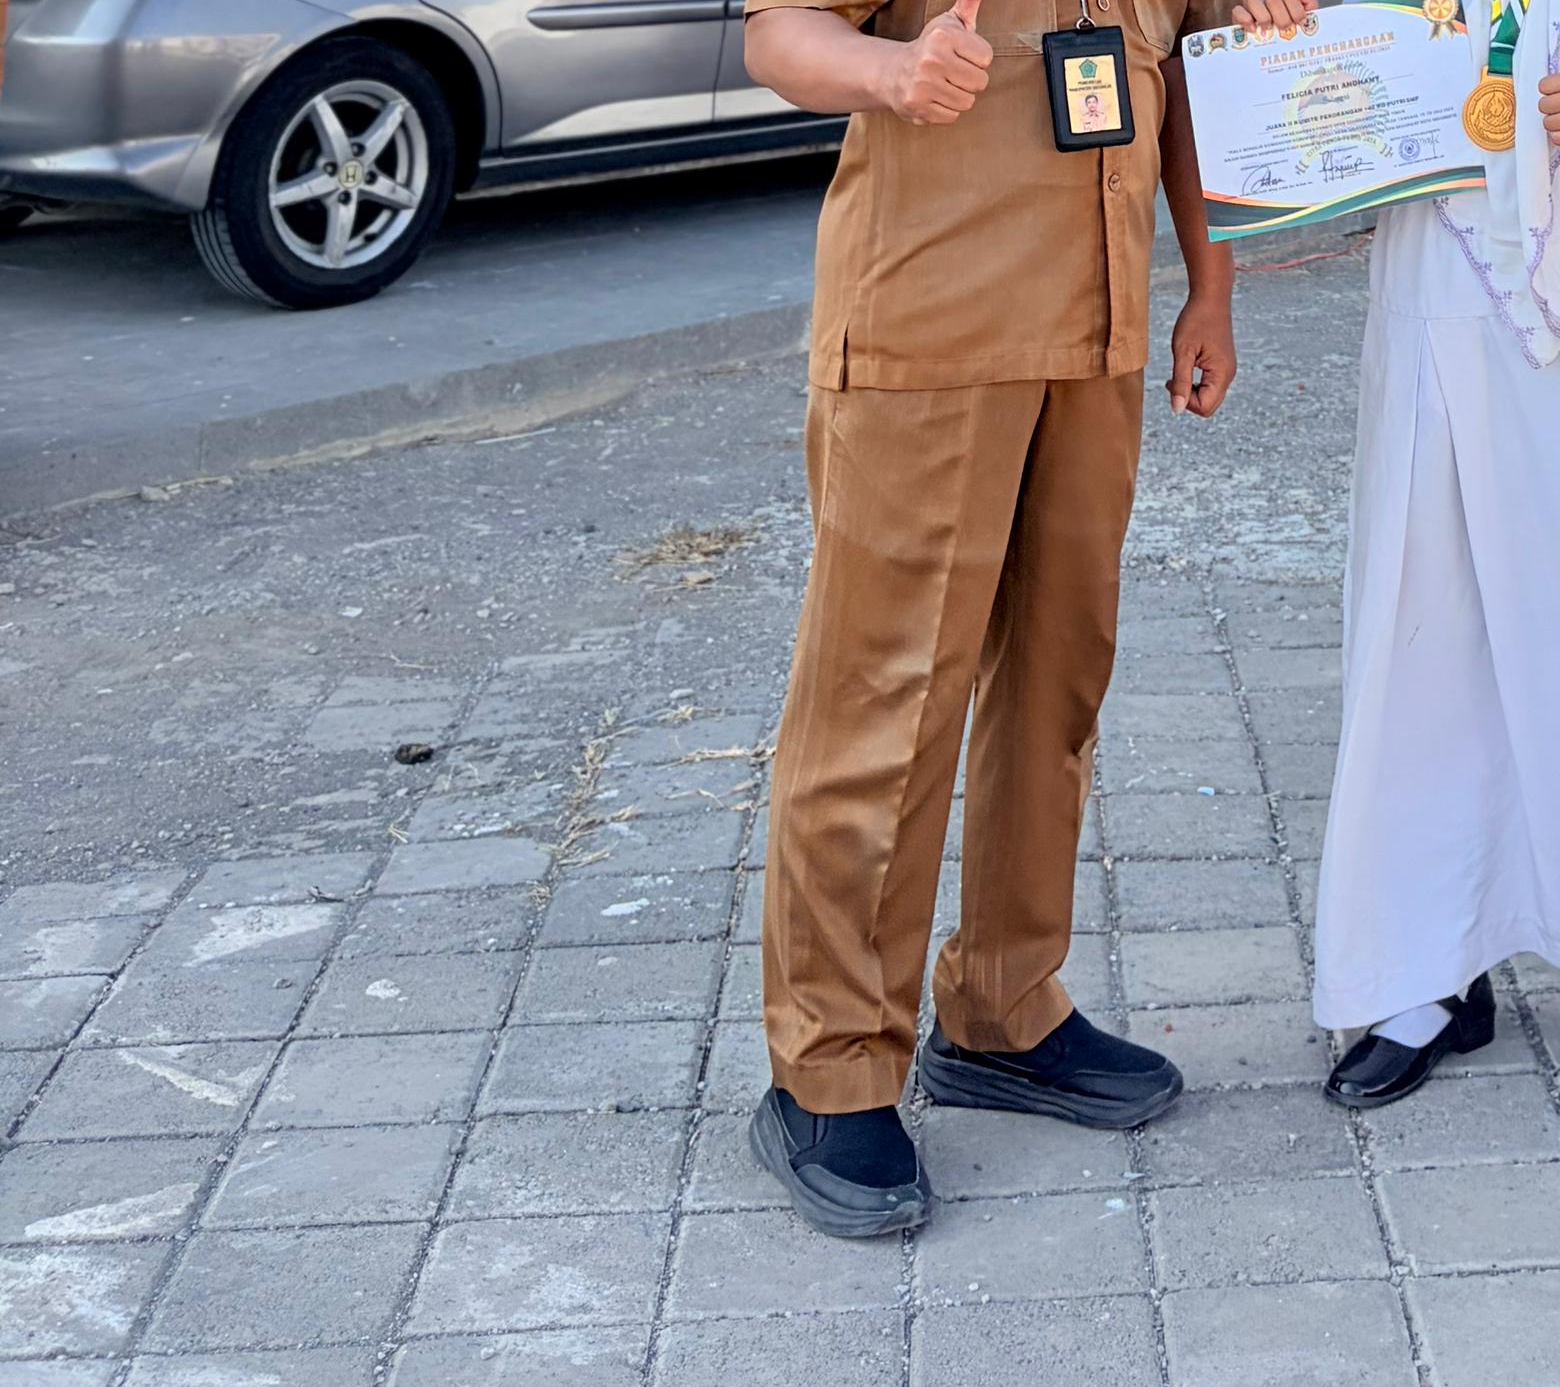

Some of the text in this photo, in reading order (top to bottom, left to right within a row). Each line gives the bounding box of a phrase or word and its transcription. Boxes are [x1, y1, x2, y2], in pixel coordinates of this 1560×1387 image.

[1260, 49, 1305, 66] PIAGAM
[1281, 88, 1313, 101] FELICIA
[1315, 83, 1339, 94] PUTRI
